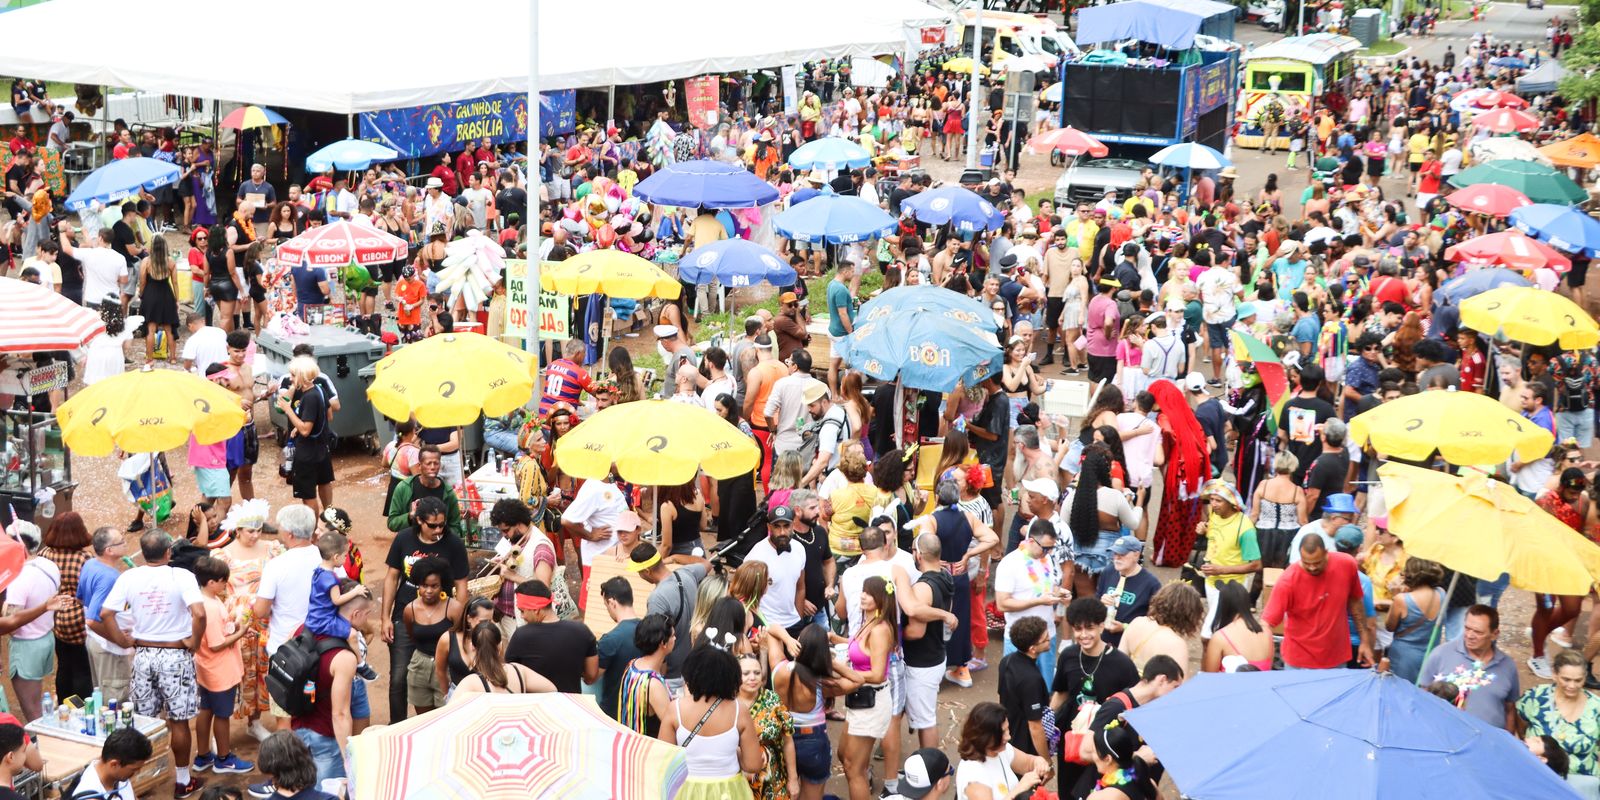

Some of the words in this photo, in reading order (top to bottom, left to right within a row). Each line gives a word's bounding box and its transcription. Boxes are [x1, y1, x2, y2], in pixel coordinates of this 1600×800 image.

[456, 101, 491, 119] GALINHO
[492, 100, 503, 114] DE
[456, 115, 503, 142] BRASÍLIA
[153, 176, 169, 187] VISA
[840, 233, 860, 244] VISA
[315, 252, 343, 263] KIBON
[362, 251, 388, 260] KIBON
[732, 275, 750, 286] BOA
[910, 341, 950, 367] BOA
[488, 378, 508, 390] SKOL
[547, 373, 564, 396] 10
[139, 417, 165, 426] SKOL
